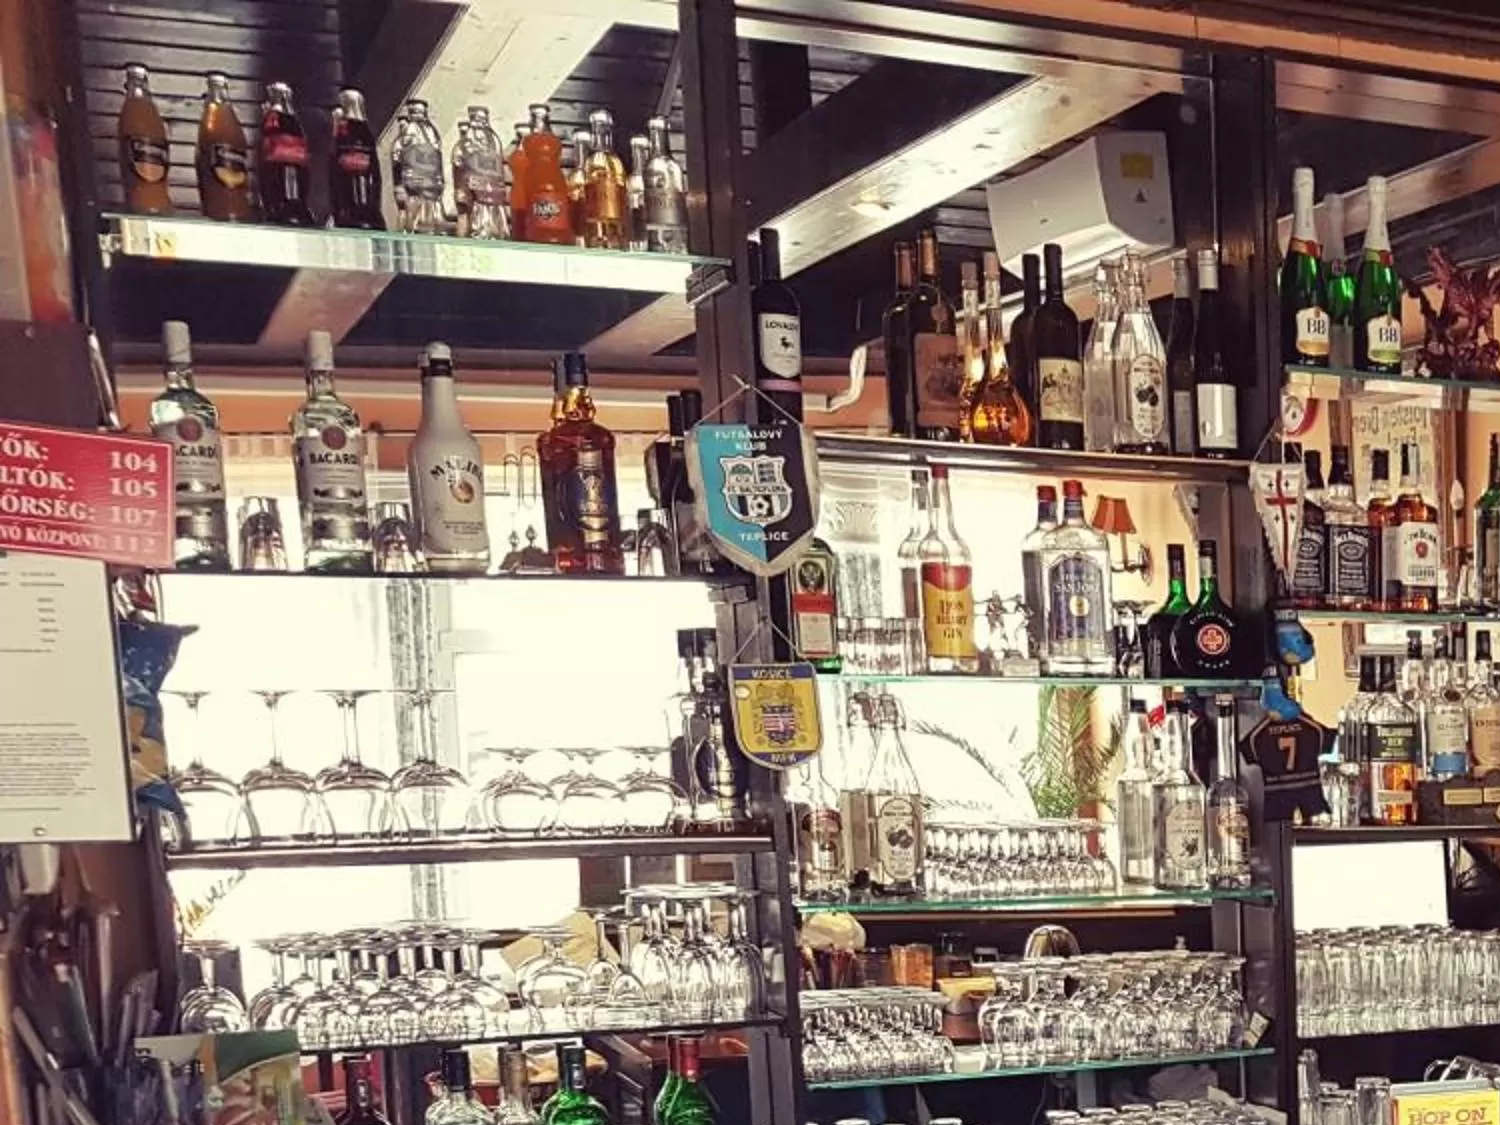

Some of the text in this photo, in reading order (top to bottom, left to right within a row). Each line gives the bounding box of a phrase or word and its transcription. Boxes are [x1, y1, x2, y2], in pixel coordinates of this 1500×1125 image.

[109, 451, 158, 474] 104
[109, 477, 158, 498] 105
[110, 505, 158, 528] 107
[110, 535, 156, 554] 112
[1277, 735, 1297, 771] 7
[1455, 1106, 1487, 1123] ON
